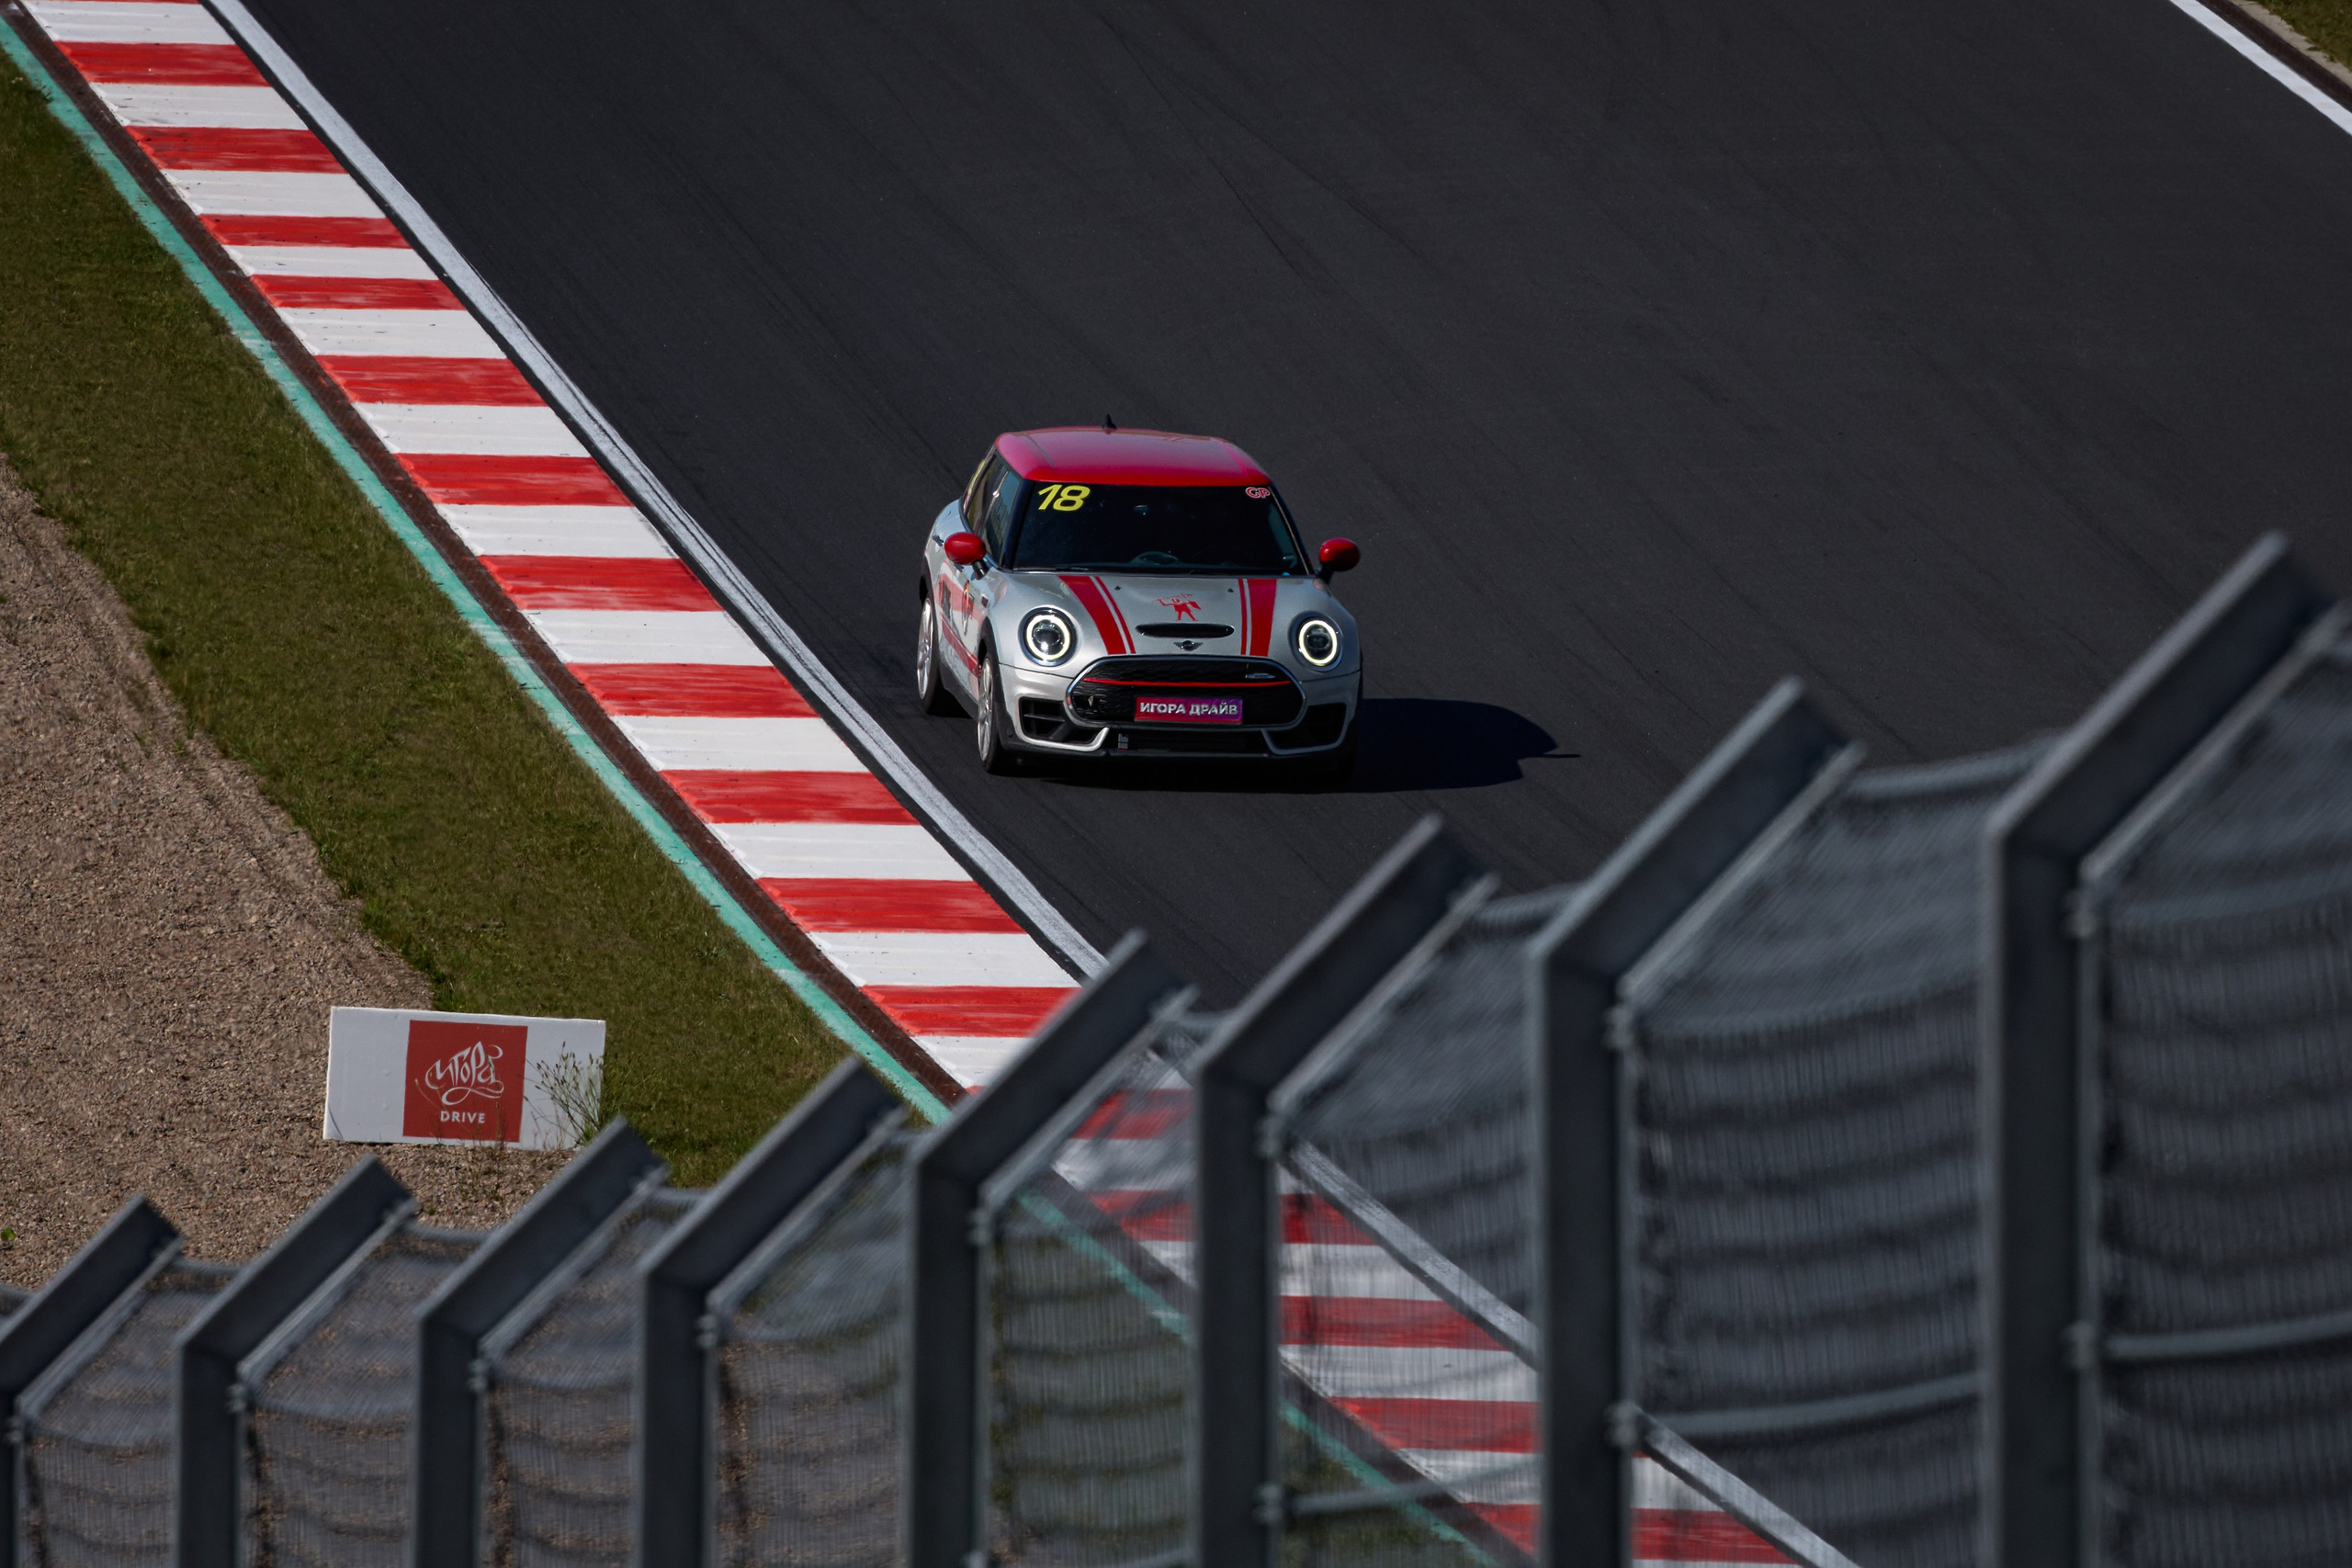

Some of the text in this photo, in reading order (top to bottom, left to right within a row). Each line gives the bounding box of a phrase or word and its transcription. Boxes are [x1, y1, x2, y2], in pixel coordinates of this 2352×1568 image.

[1038, 484, 1091, 512] 18
[1140, 702, 1238, 716] ИГОРА ДРАЙВ
[440, 1111, 486, 1123] DRIVE
